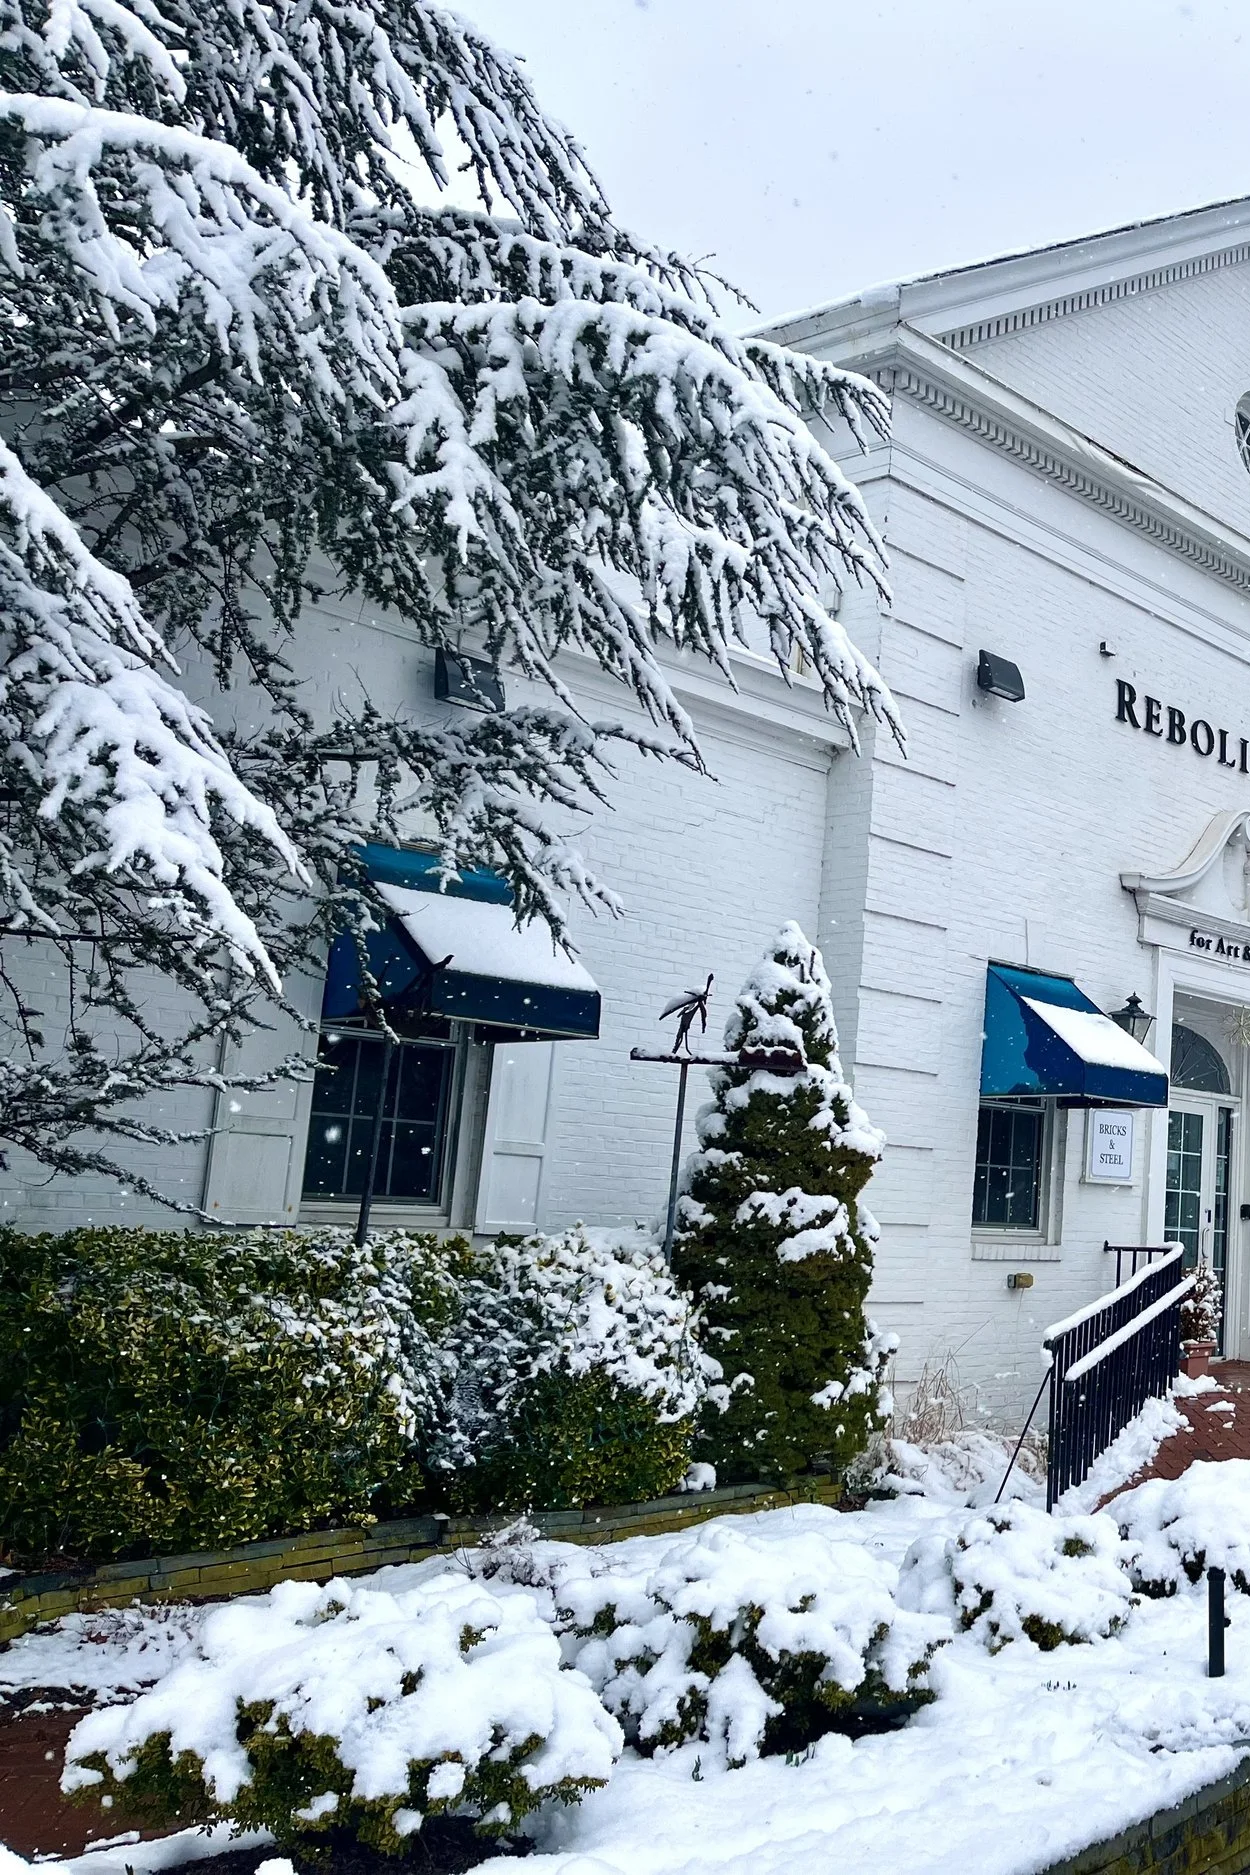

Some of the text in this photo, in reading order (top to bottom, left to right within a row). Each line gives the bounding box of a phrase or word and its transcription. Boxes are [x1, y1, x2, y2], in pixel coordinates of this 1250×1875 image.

[1115, 678, 1249, 774] REBOLI
[1189, 929, 1213, 951] for
[1215, 937, 1240, 958] Art
[1099, 1123, 1127, 1136] BRICKS
[1109, 1139, 1115, 1150] &
[1100, 1153, 1123, 1165] STEEL
